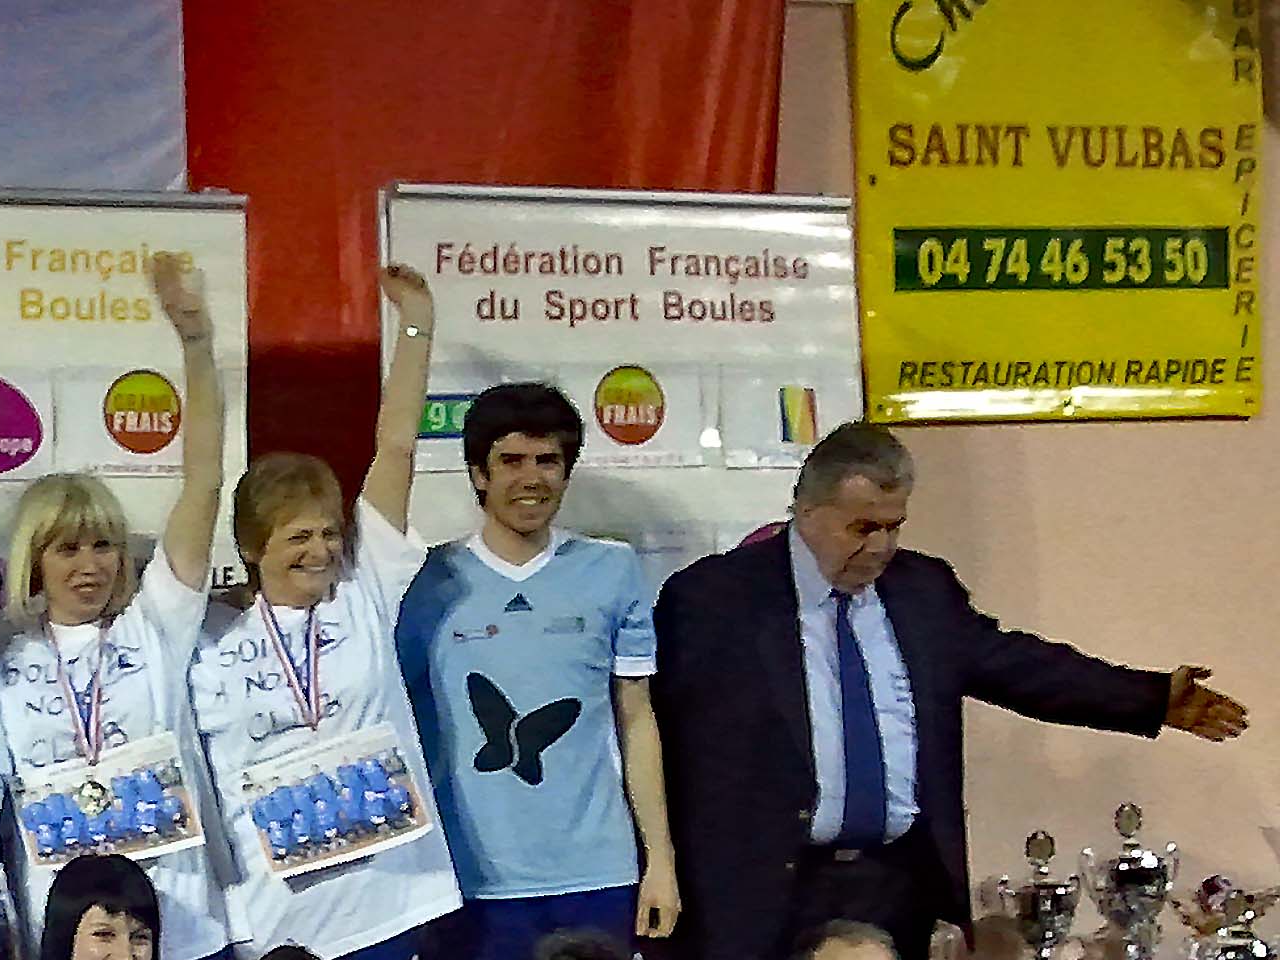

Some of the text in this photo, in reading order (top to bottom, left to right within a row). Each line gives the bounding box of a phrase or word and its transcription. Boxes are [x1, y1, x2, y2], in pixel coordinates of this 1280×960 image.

[887, 122, 1227, 170] SAINT VULBAS
[435, 241, 809, 284] Fédération Française
[917, 237, 1210, 286] 04 74 46 53 50
[20, 287, 152, 321] Boules
[476, 288, 776, 327] du Sport Boules
[898, 357, 1227, 388] RESTAURATION RAPIDE
